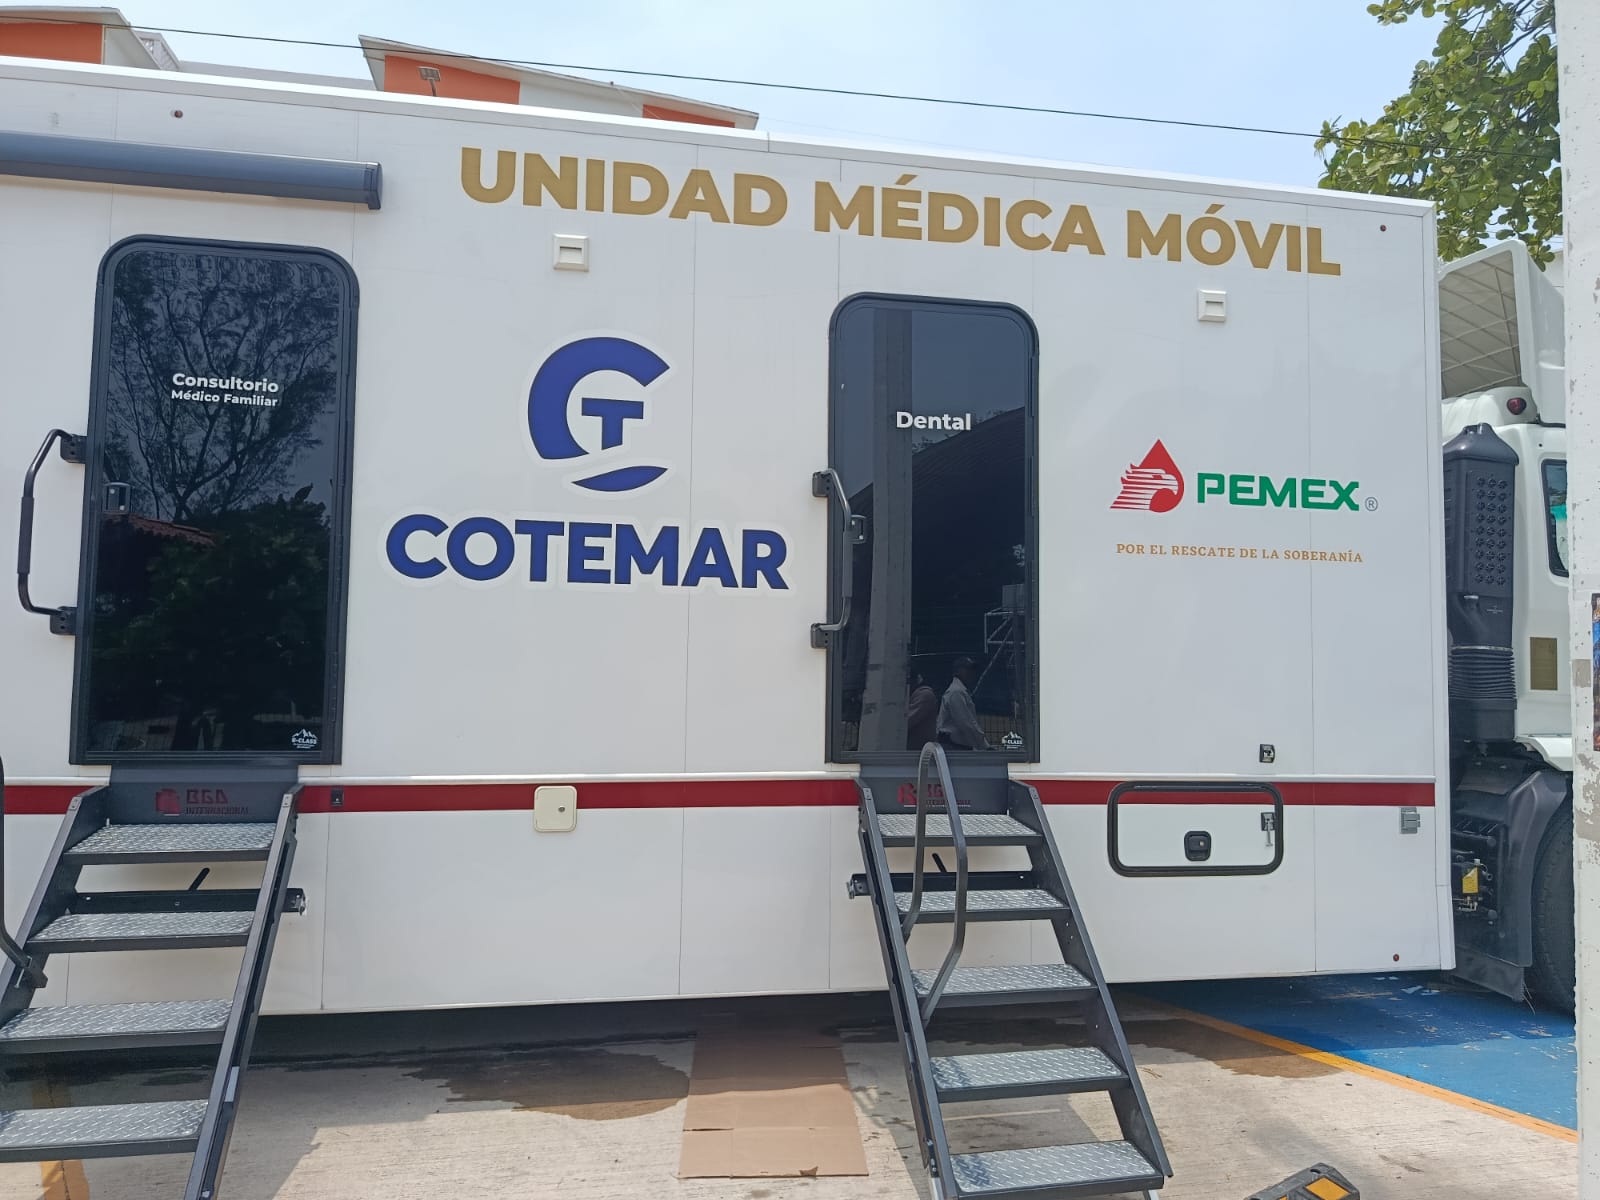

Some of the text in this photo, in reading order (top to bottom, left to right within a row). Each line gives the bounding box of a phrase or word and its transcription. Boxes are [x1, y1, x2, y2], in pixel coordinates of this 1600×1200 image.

[461, 147, 1341, 276] UNIDAD MÉDICA MÓVIL
[172, 373, 279, 393] Consultorio
[171, 389, 278, 407] Médico Familiar
[896, 411, 971, 430] Dental
[1197, 472, 1359, 511] PEMEX
[386, 514, 788, 589] COTEMAR
[1116, 543, 1363, 562] POR EL RESCATE DE LA SOBERANÍA
